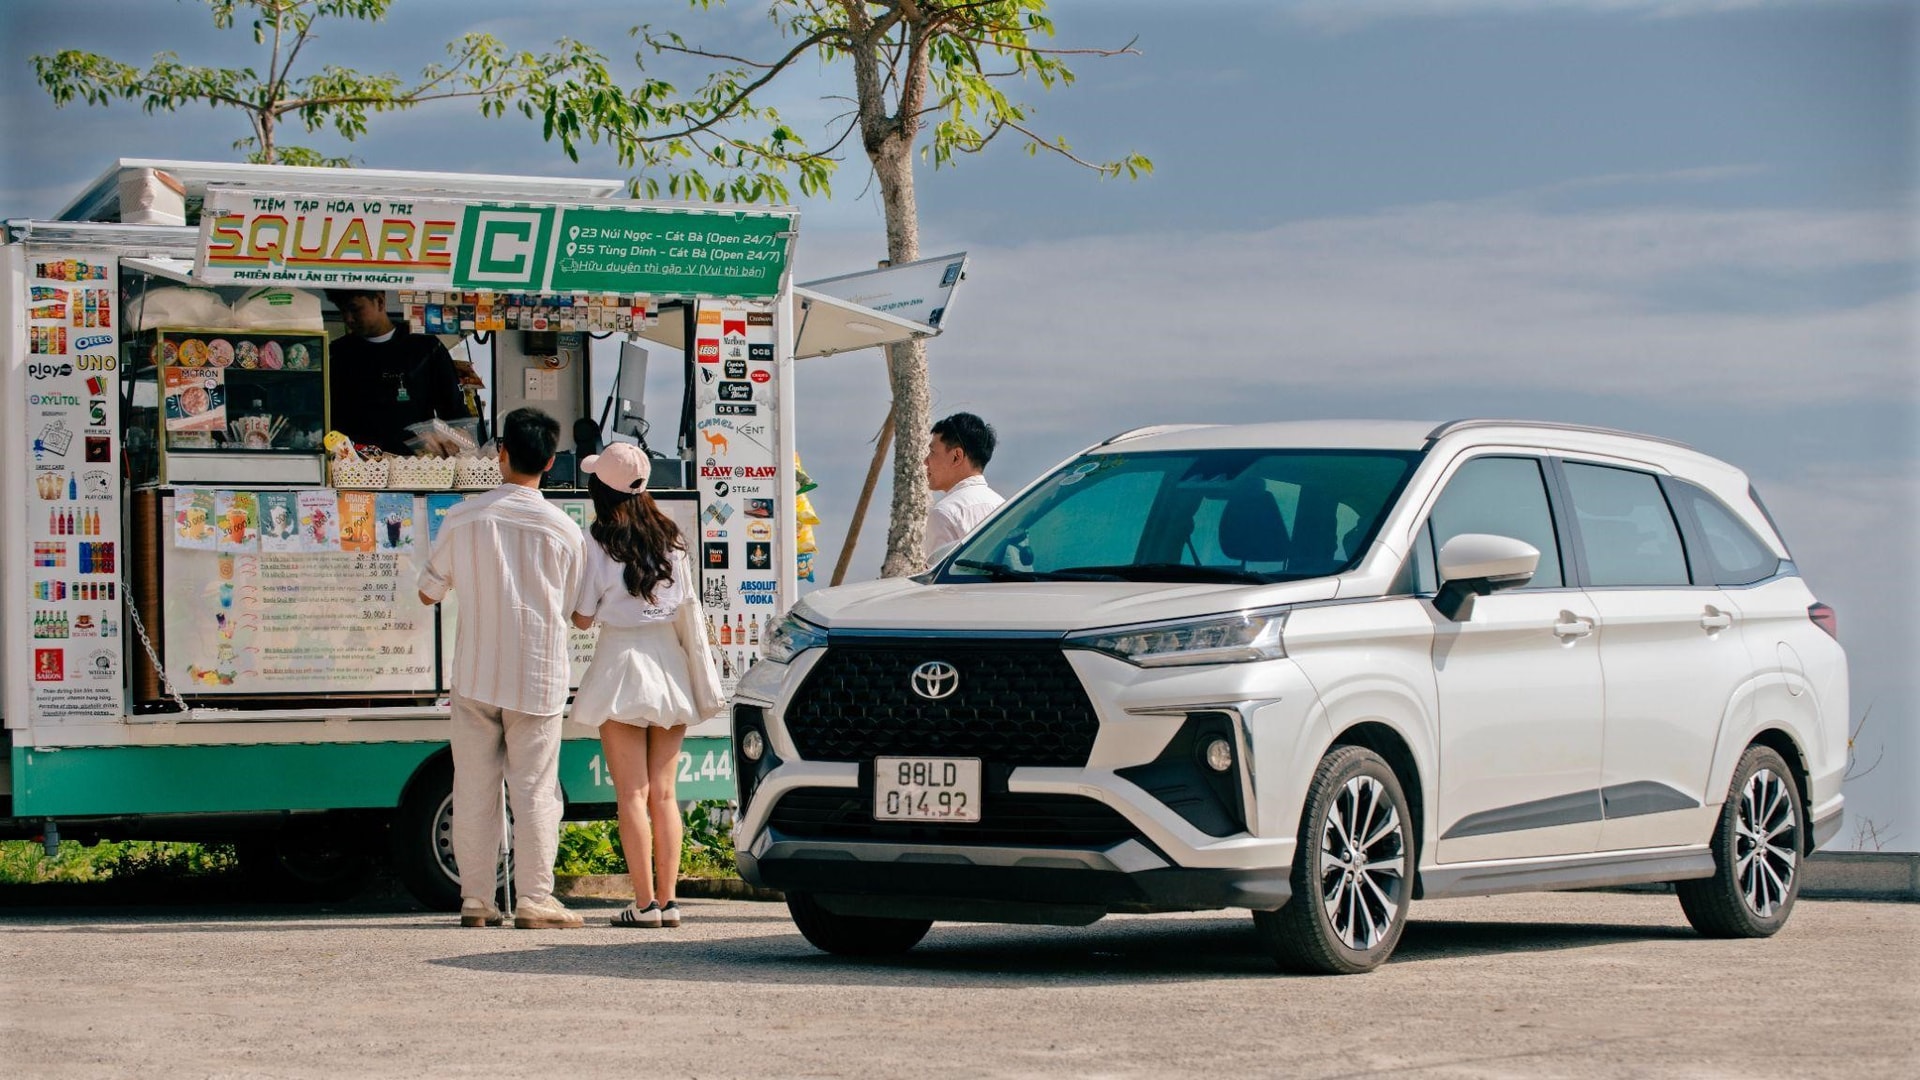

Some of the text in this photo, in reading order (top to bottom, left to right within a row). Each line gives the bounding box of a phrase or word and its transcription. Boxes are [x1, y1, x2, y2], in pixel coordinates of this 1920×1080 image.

[253, 198, 286, 213] TIỆM
[294, 200, 319, 214] TẠP
[326, 200, 354, 213] HÓA
[389, 203, 413, 215] TRI
[207, 214, 456, 265] SQUARE
[580, 228, 597, 239] 23
[601, 228, 621, 239] Núi
[624, 229, 653, 242] Ngọc
[665, 230, 685, 242] Cát
[688, 231, 702, 242] Bà
[706, 231, 740, 246] (Open
[742, 233, 777, 247] 24/7)
[578, 244, 595, 255] 55
[598, 244, 627, 258] Tùng
[669, 247, 688, 258] Cát
[691, 247, 707, 259] Bà
[710, 248, 744, 261] (Open
[746, 249, 781, 264] 24/7)
[233, 269, 271, 280] PHIÊN
[273, 270, 296, 280] BẢN
[324, 273, 338, 282] ĐI
[341, 272, 362, 282] TÌM
[364, 274, 403, 284] KHÁCH
[579, 261, 602, 271] Hữu
[606, 262, 641, 273] duyên
[700, 264, 721, 276] (Vui
[743, 266, 765, 279] bán)
[76, 335, 113, 349] OREO
[699, 345, 718, 356] LEGO
[752, 348, 771, 356] OCB
[76, 354, 117, 371] UNO
[29, 363, 60, 378] play
[728, 383, 750, 392] Captain
[41, 395, 81, 406] XYLITOL
[718, 406, 740, 414] OCB
[697, 417, 734, 430] CAMEL
[700, 466, 733, 477] RAW
[744, 466, 777, 478] RAW
[732, 485, 759, 493] STEAM
[345, 494, 371, 504] ORANGE
[740, 581, 777, 591] ABSOLUT
[744, 594, 774, 605] VODKA
[898, 762, 957, 787] 88LD
[886, 791, 968, 817] 014.92
